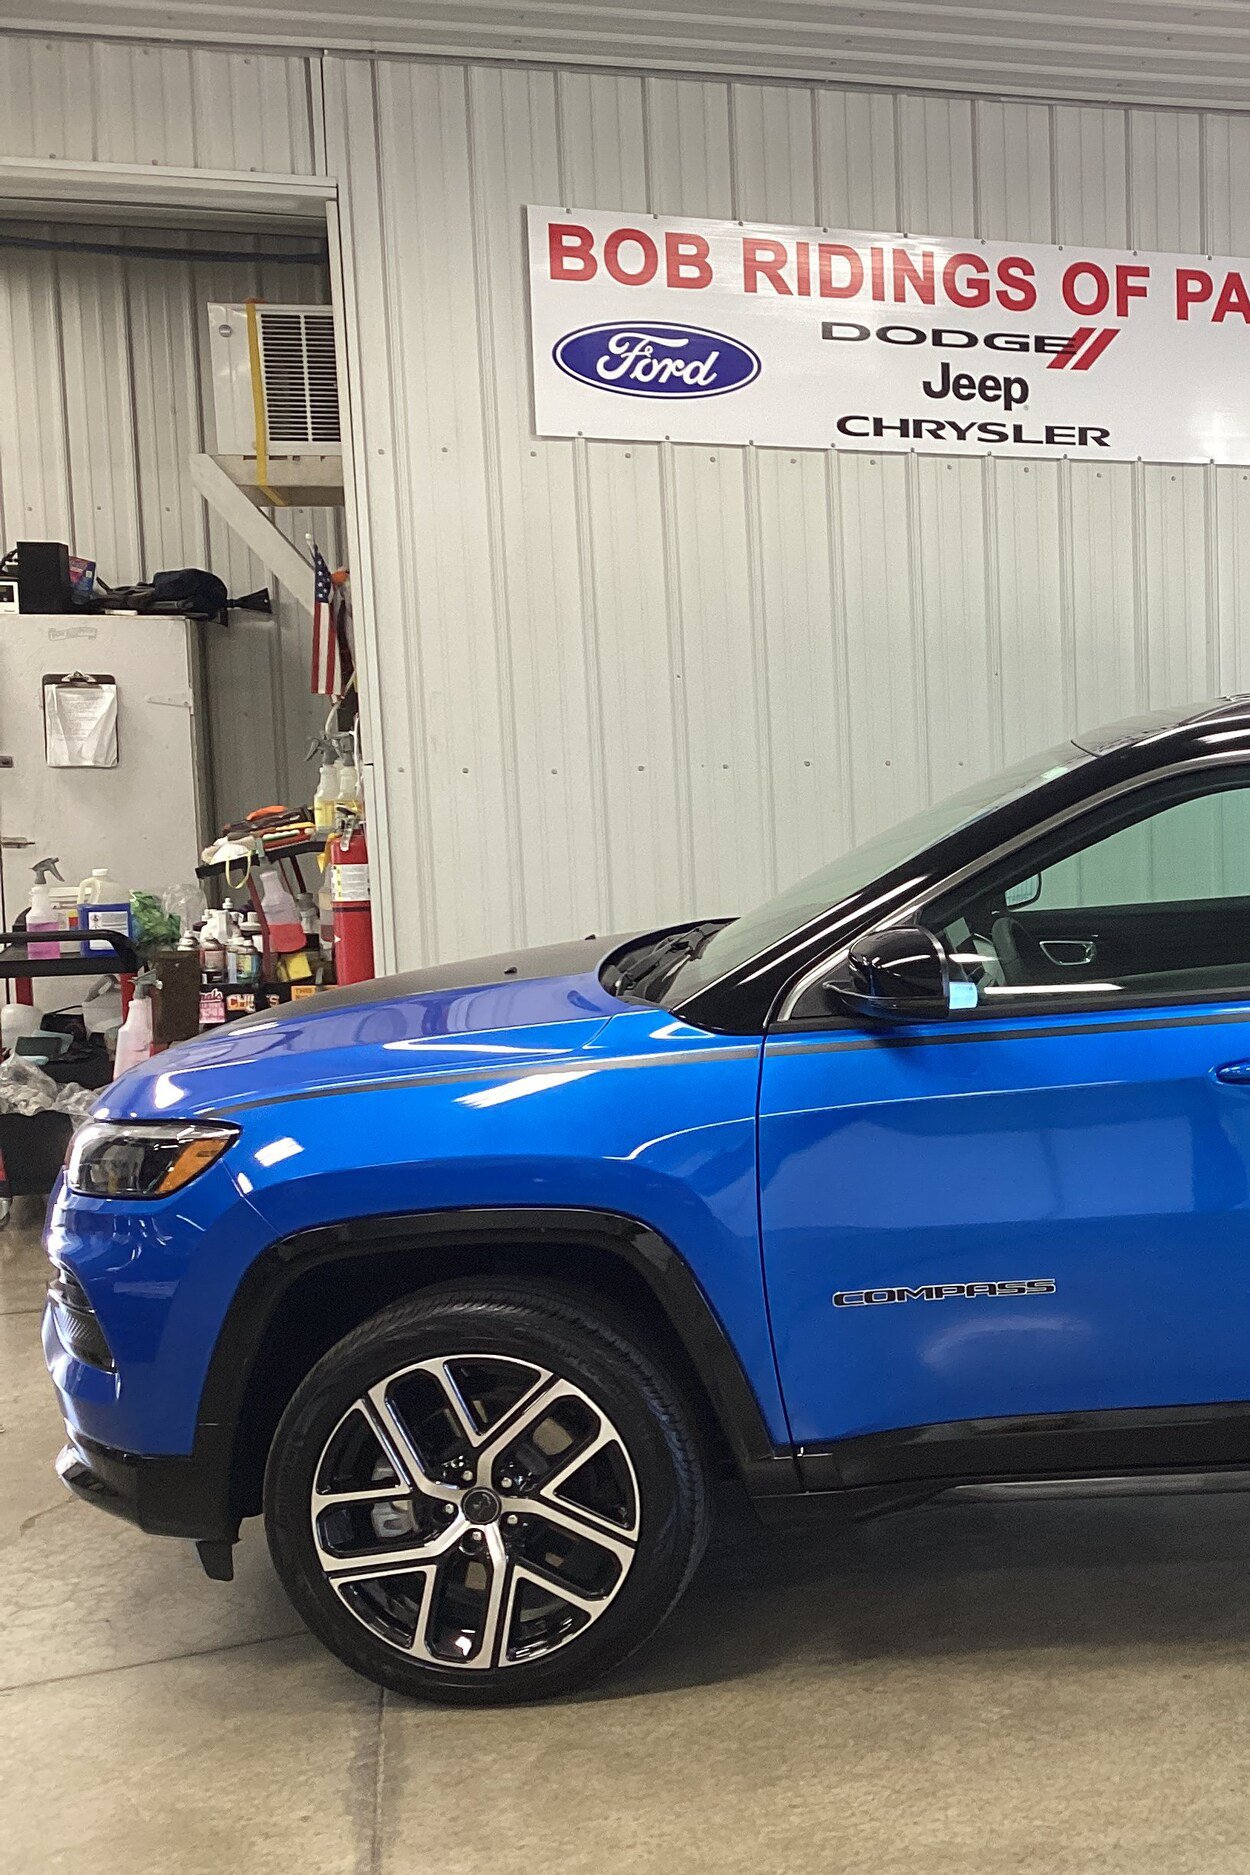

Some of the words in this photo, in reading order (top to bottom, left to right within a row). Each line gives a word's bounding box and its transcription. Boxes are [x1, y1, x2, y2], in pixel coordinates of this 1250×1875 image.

[548, 223, 713, 290] BOB
[742, 237, 1036, 311] RIDINGS
[1062, 261, 1150, 317] OF
[821, 321, 1077, 354] DODGE
[597, 332, 719, 387] Ford
[922, 362, 1029, 410] Jeep
[836, 415, 1111, 447] CHRYSLER
[832, 1278, 1056, 1308] COMPASS
